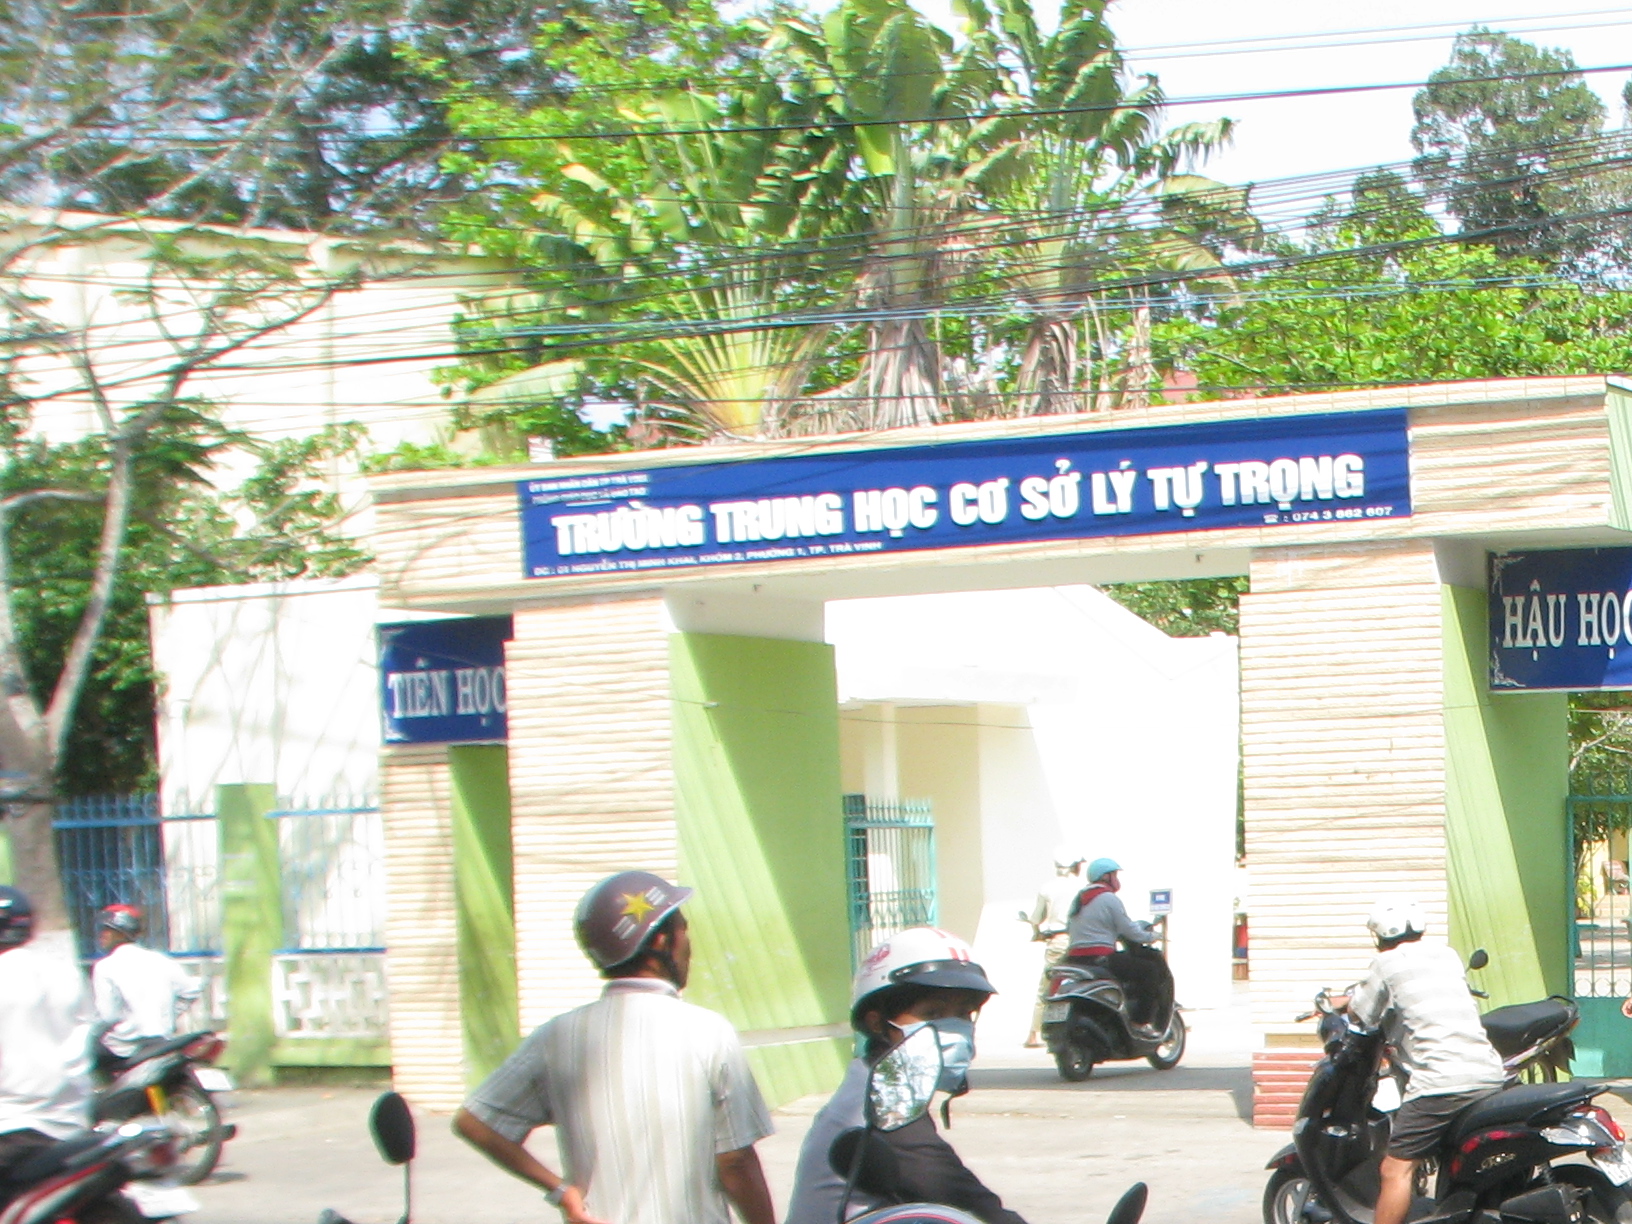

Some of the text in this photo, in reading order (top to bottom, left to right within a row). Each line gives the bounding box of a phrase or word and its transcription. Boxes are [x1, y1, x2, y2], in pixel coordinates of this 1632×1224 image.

[551, 453, 1365, 556] TRƯỜNG TRUNG HỌC CƠ SỞ LÝ TỰ TRỌNG
[1502, 579, 1567, 662] HẬU
[387, 657, 450, 719] TIÊN
